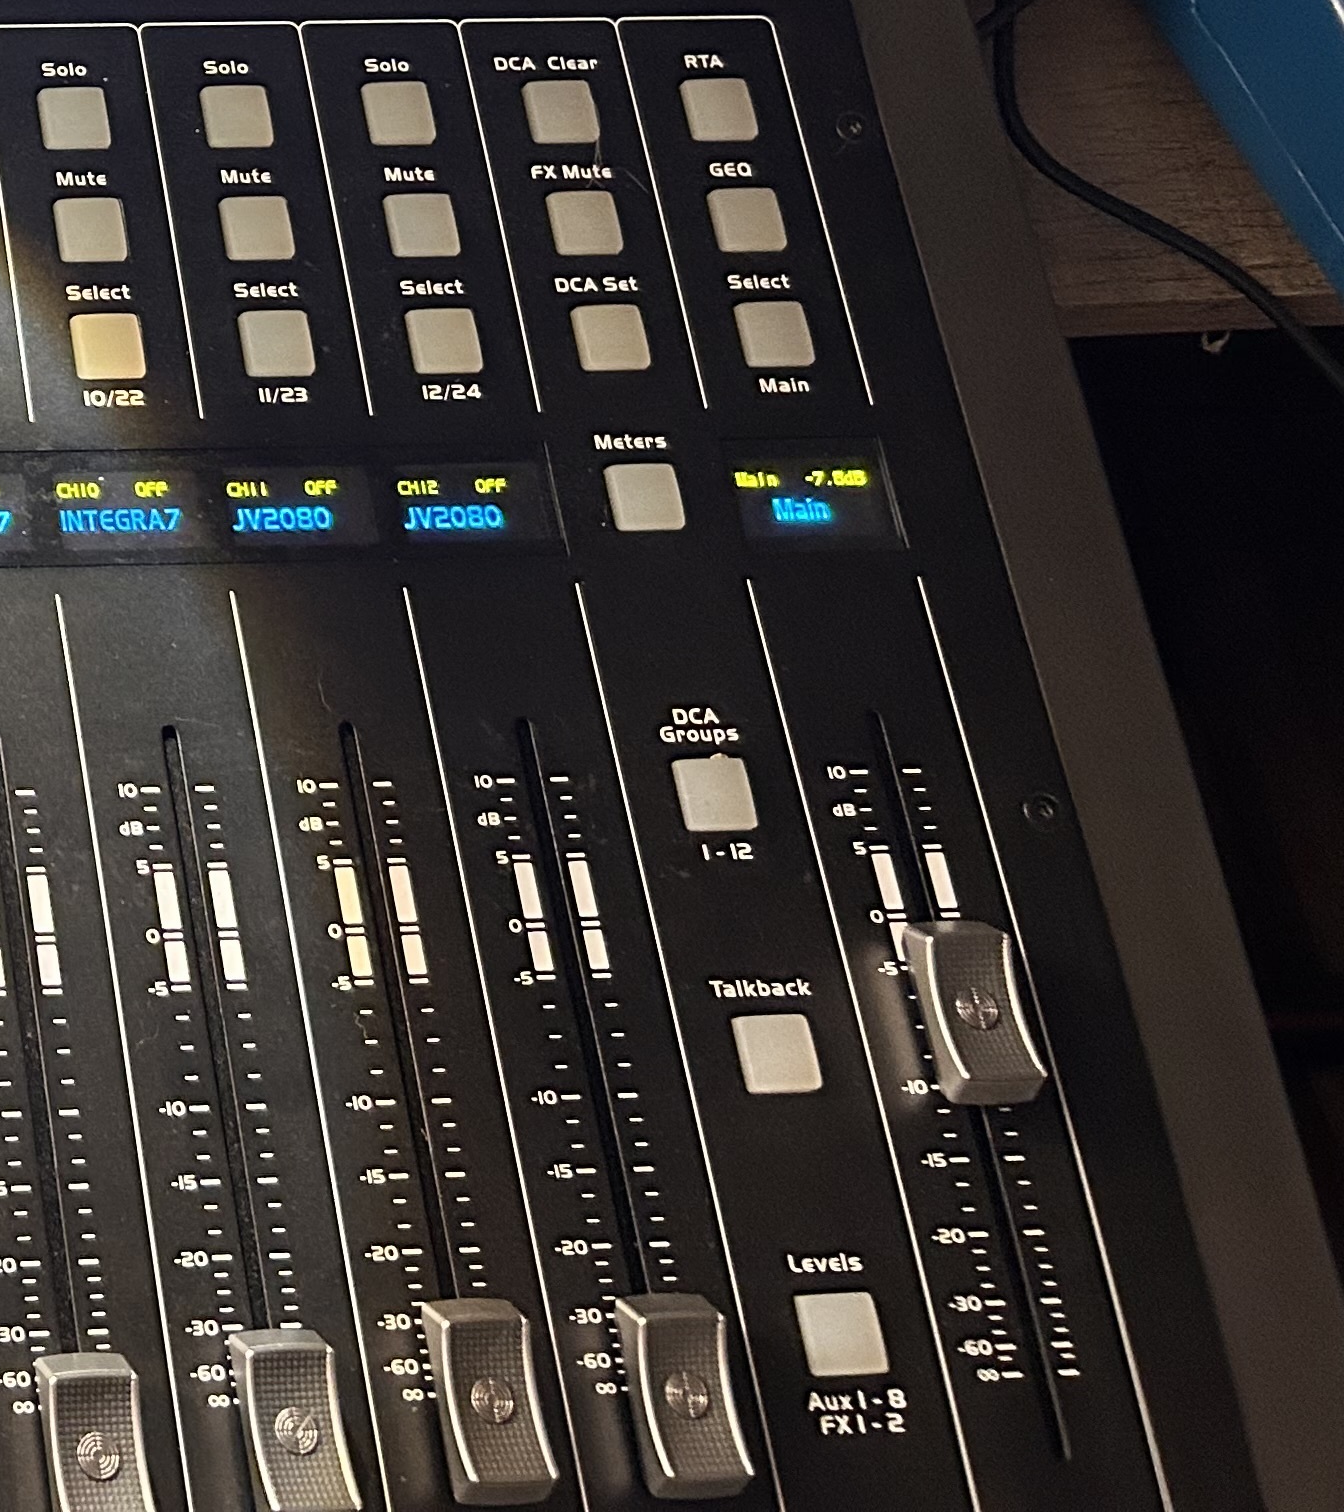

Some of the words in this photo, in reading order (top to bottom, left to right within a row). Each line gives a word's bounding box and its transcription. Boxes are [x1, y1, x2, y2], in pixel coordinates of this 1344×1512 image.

[203, 61, 248, 74] Solo
[494, 57, 536, 70] DCA
[547, 56, 597, 70] Clear
[684, 55, 724, 68] RTA
[531, 165, 557, 179] FX
[562, 165, 612, 179] Mute
[710, 163, 752, 176] GEQ
[555, 278, 598, 292] DCA
[603, 277, 638, 291] Set
[728, 274, 790, 289] Select
[234, 282, 298, 297] Select
[422, 384, 481, 400] 12/24
[759, 378, 809, 392] Main
[83, 390, 145, 407] 10/22
[259, 387, 308, 403] 11/23
[594, 434, 667, 449] Meters
[772, 497, 831, 523] Main
[233, 506, 333, 531] JV2080
[672, 708, 719, 724] DCA
[660, 726, 739, 745] Groups
[709, 979, 812, 997] Talkback
[932, 1228, 965, 1244] -20
[787, 1253, 863, 1273] Levels
